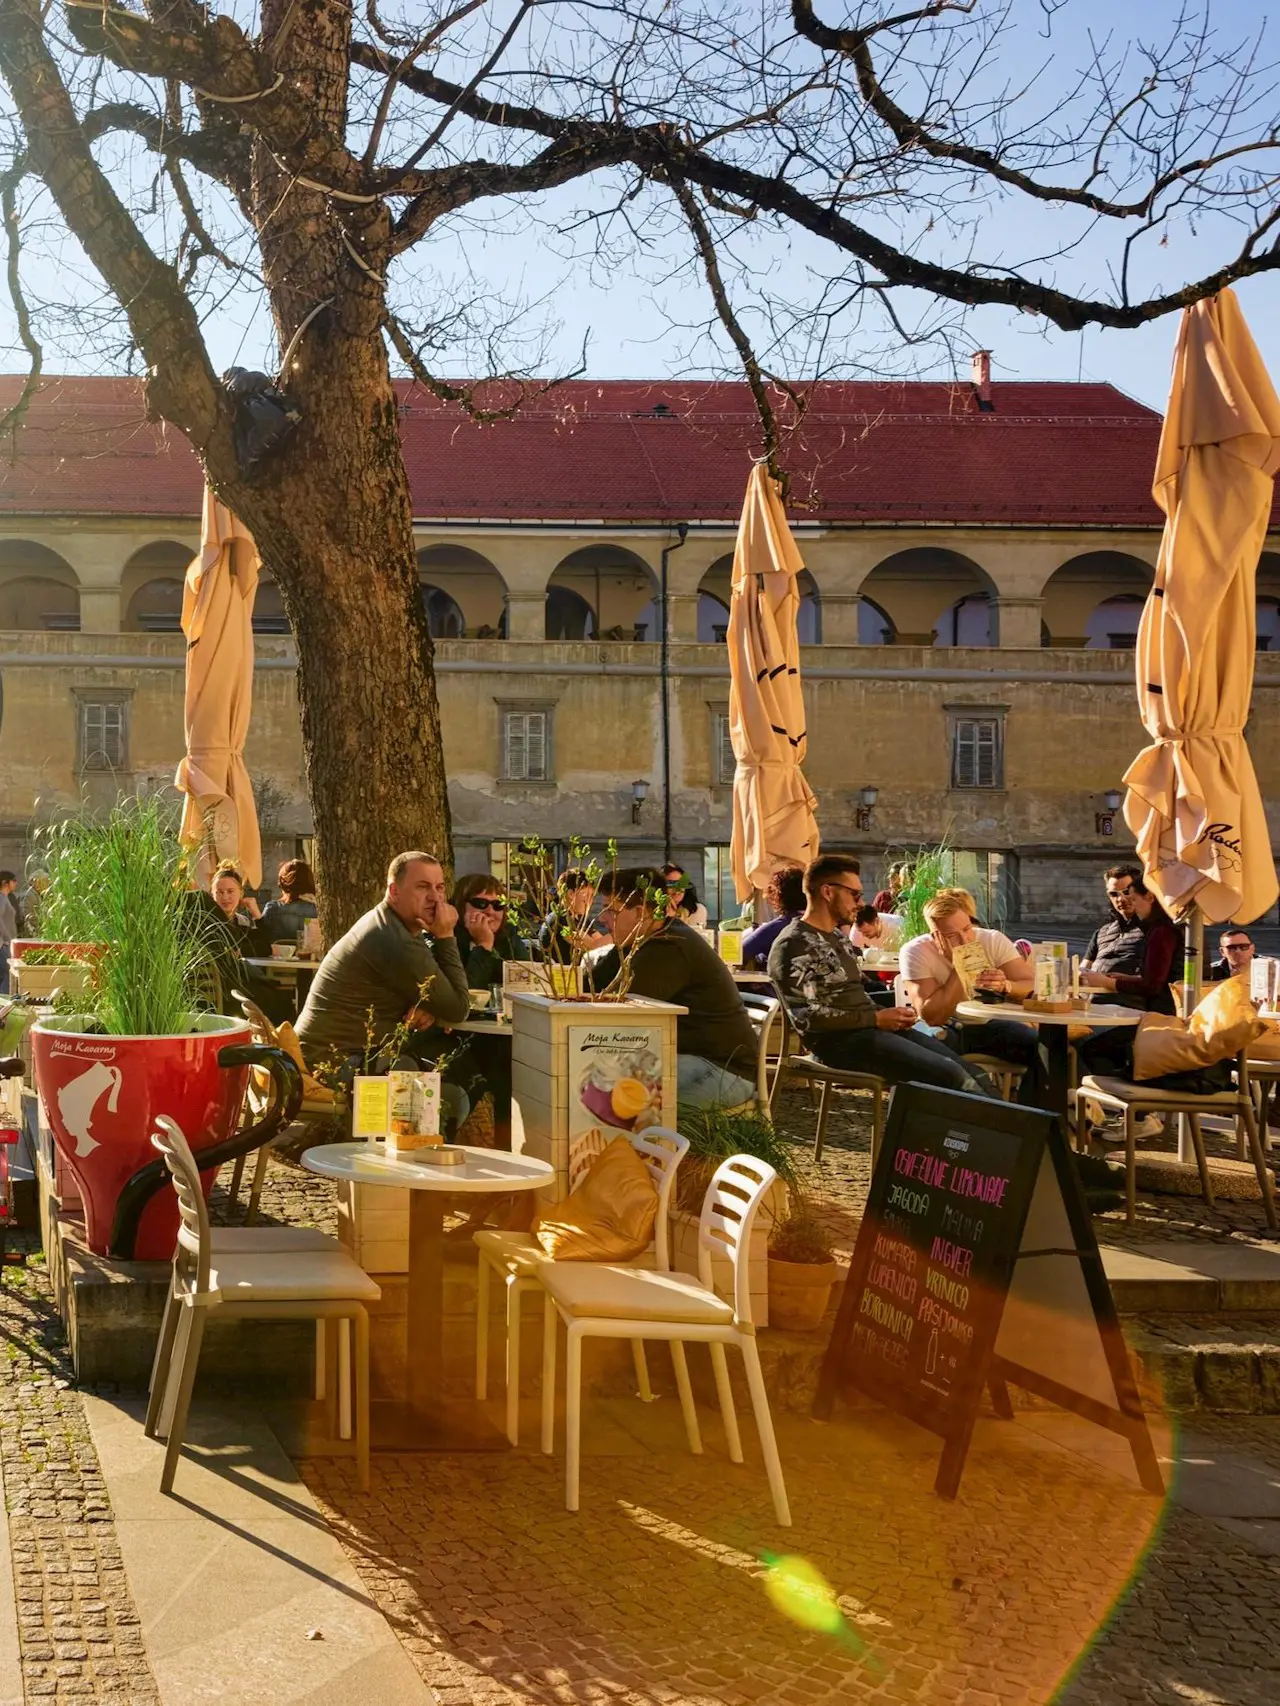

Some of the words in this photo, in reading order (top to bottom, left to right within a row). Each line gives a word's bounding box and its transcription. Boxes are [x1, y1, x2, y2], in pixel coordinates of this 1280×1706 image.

[1197, 823, 1242, 856] Rade
[51, 1039, 73, 1053] Moja
[75, 1041, 117, 1055] Kavarna
[582, 1032, 609, 1046] Moja
[611, 1032, 650, 1044] Kavarna
[887, 1183, 930, 1217] JAGODA
[950, 1166, 1010, 1209] LIMONADE
[873, 1232, 917, 1273] KUMARA
[930, 1236, 974, 1278] INGVER
[867, 1260, 918, 1304] LUBENICA
[925, 1266, 969, 1311] VRTNICA
[860, 1287, 914, 1343] BOROVNICA
